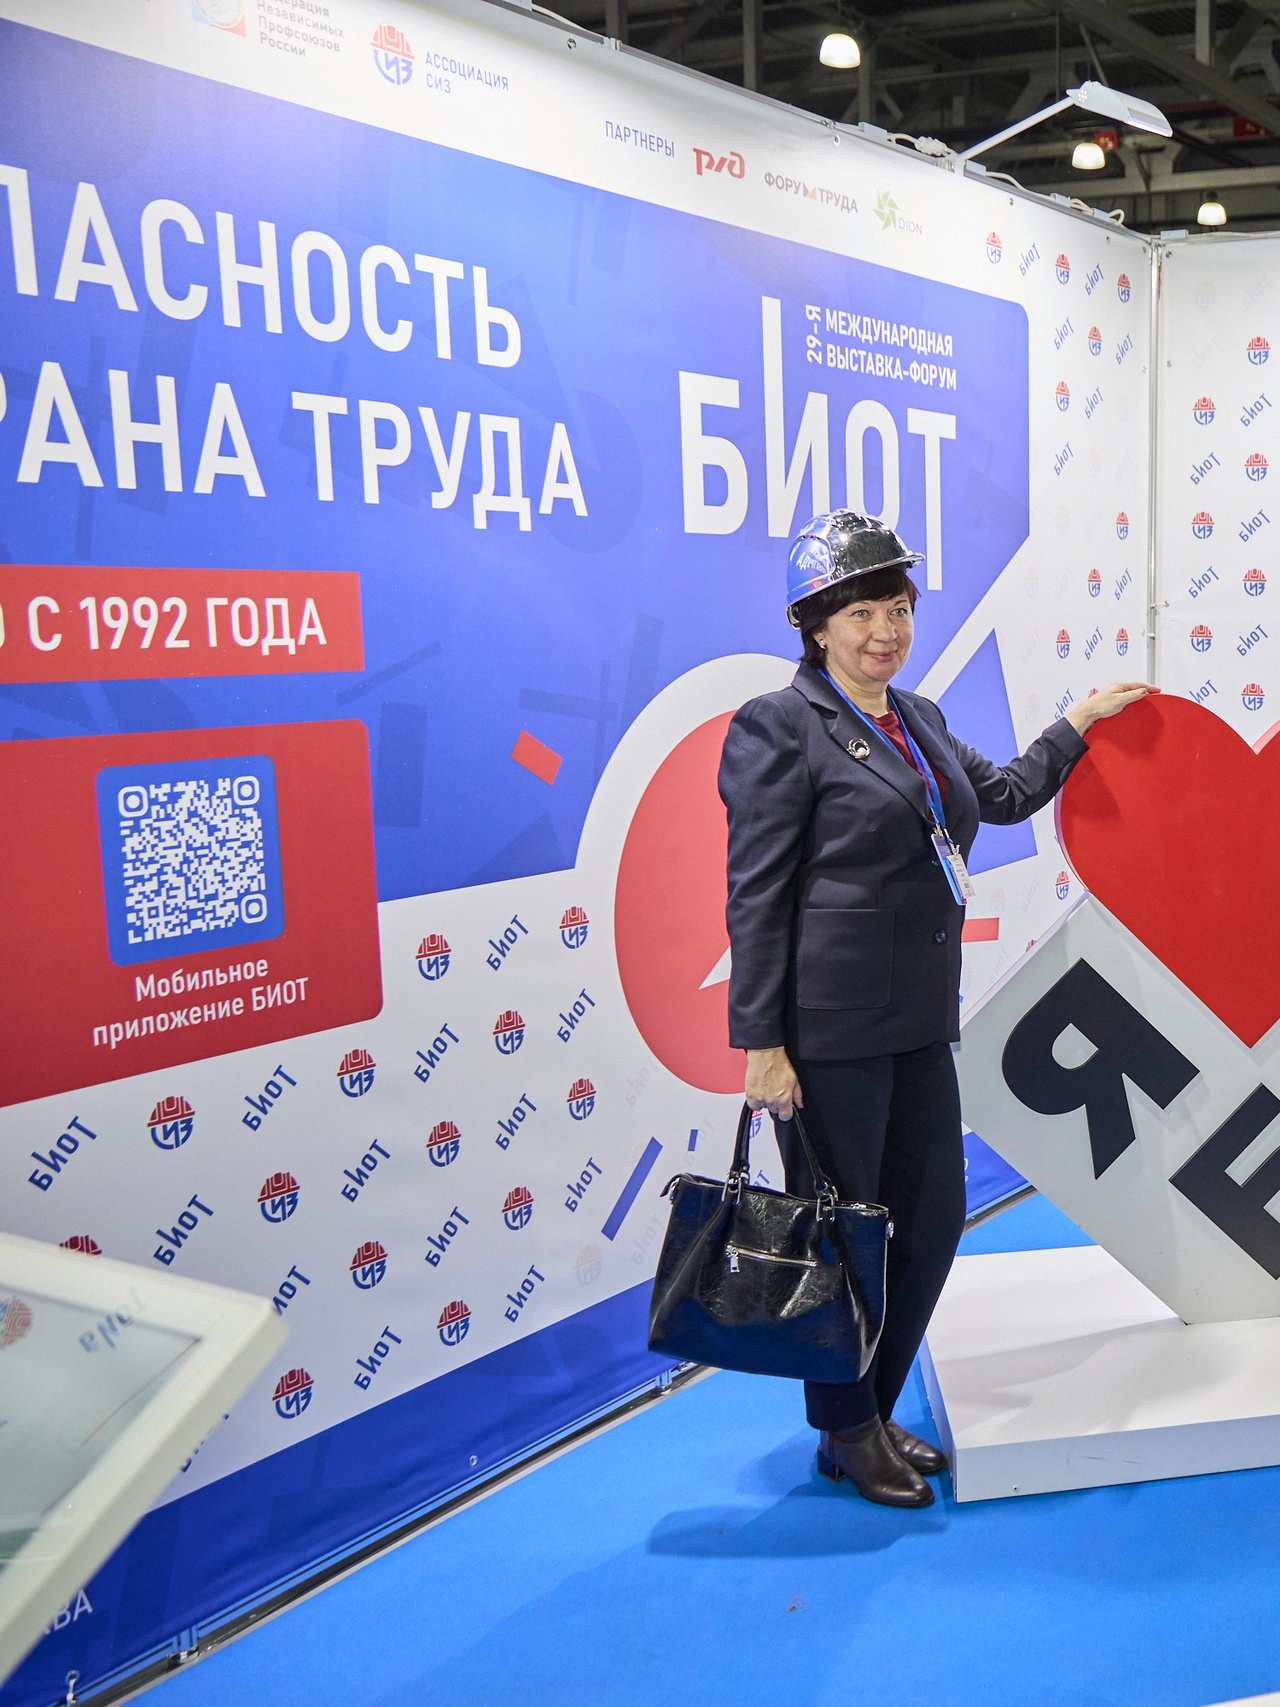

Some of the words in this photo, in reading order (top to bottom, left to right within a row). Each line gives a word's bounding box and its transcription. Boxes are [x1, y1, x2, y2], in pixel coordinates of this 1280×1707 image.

[259, 15, 341, 52] Профсоюзов
[260, 32, 307, 57] России
[425, 51, 509, 91] АССОЦИАЦИЯ
[426, 73, 451, 94] СИЗ
[605, 120, 675, 158] ПАРТНЕРЫ
[818, 187, 858, 213] ТРУДА
[898, 217, 923, 235] DION
[825, 307, 953, 357] МЕЖДУНАРОДНАЯ
[826, 343, 957, 391] ВЫСТАВКА-ФОРУМ
[1240, 394, 1272, 427] БИОТ
[0, 361, 267, 498] АНА
[291, 391, 588, 531] ТРУДА
[679, 296, 957, 591] БИОТ
[1190, 452, 1221, 486] БИОТ
[1238, 510, 1270, 543] БИОТ
[1188, 566, 1219, 598] БИОТ
[28, 595, 62, 651] С
[79, 596, 190, 650] 1992
[206, 597, 327, 656] ГОДА
[1236, 625, 1268, 656] БИОТ
[486, 915, 529, 971] БИОТ
[135, 958, 269, 1002] Мобильное
[92, 997, 244, 1050] приложение
[251, 977, 309, 1012] БИОТ
[557, 989, 597, 1043] БИОТ
[414, 1023, 460, 1084] БИОТ
[1002, 958, 1200, 1180] Я
[242, 1064, 298, 1132] БИОТ
[495, 1093, 538, 1151] БИОТ
[29, 1115, 98, 1192] БИОТ
[341, 1138, 392, 1202] БИОТ
[565, 1157, 603, 1213] БИОТ
[154, 1193, 214, 1267] БИОТ
[425, 1206, 470, 1267] БИОТ
[271, 1264, 312, 1315] ИОТ
[505, 1264, 546, 1323] БИОТ
[354, 1326, 403, 1391] БИОТ
